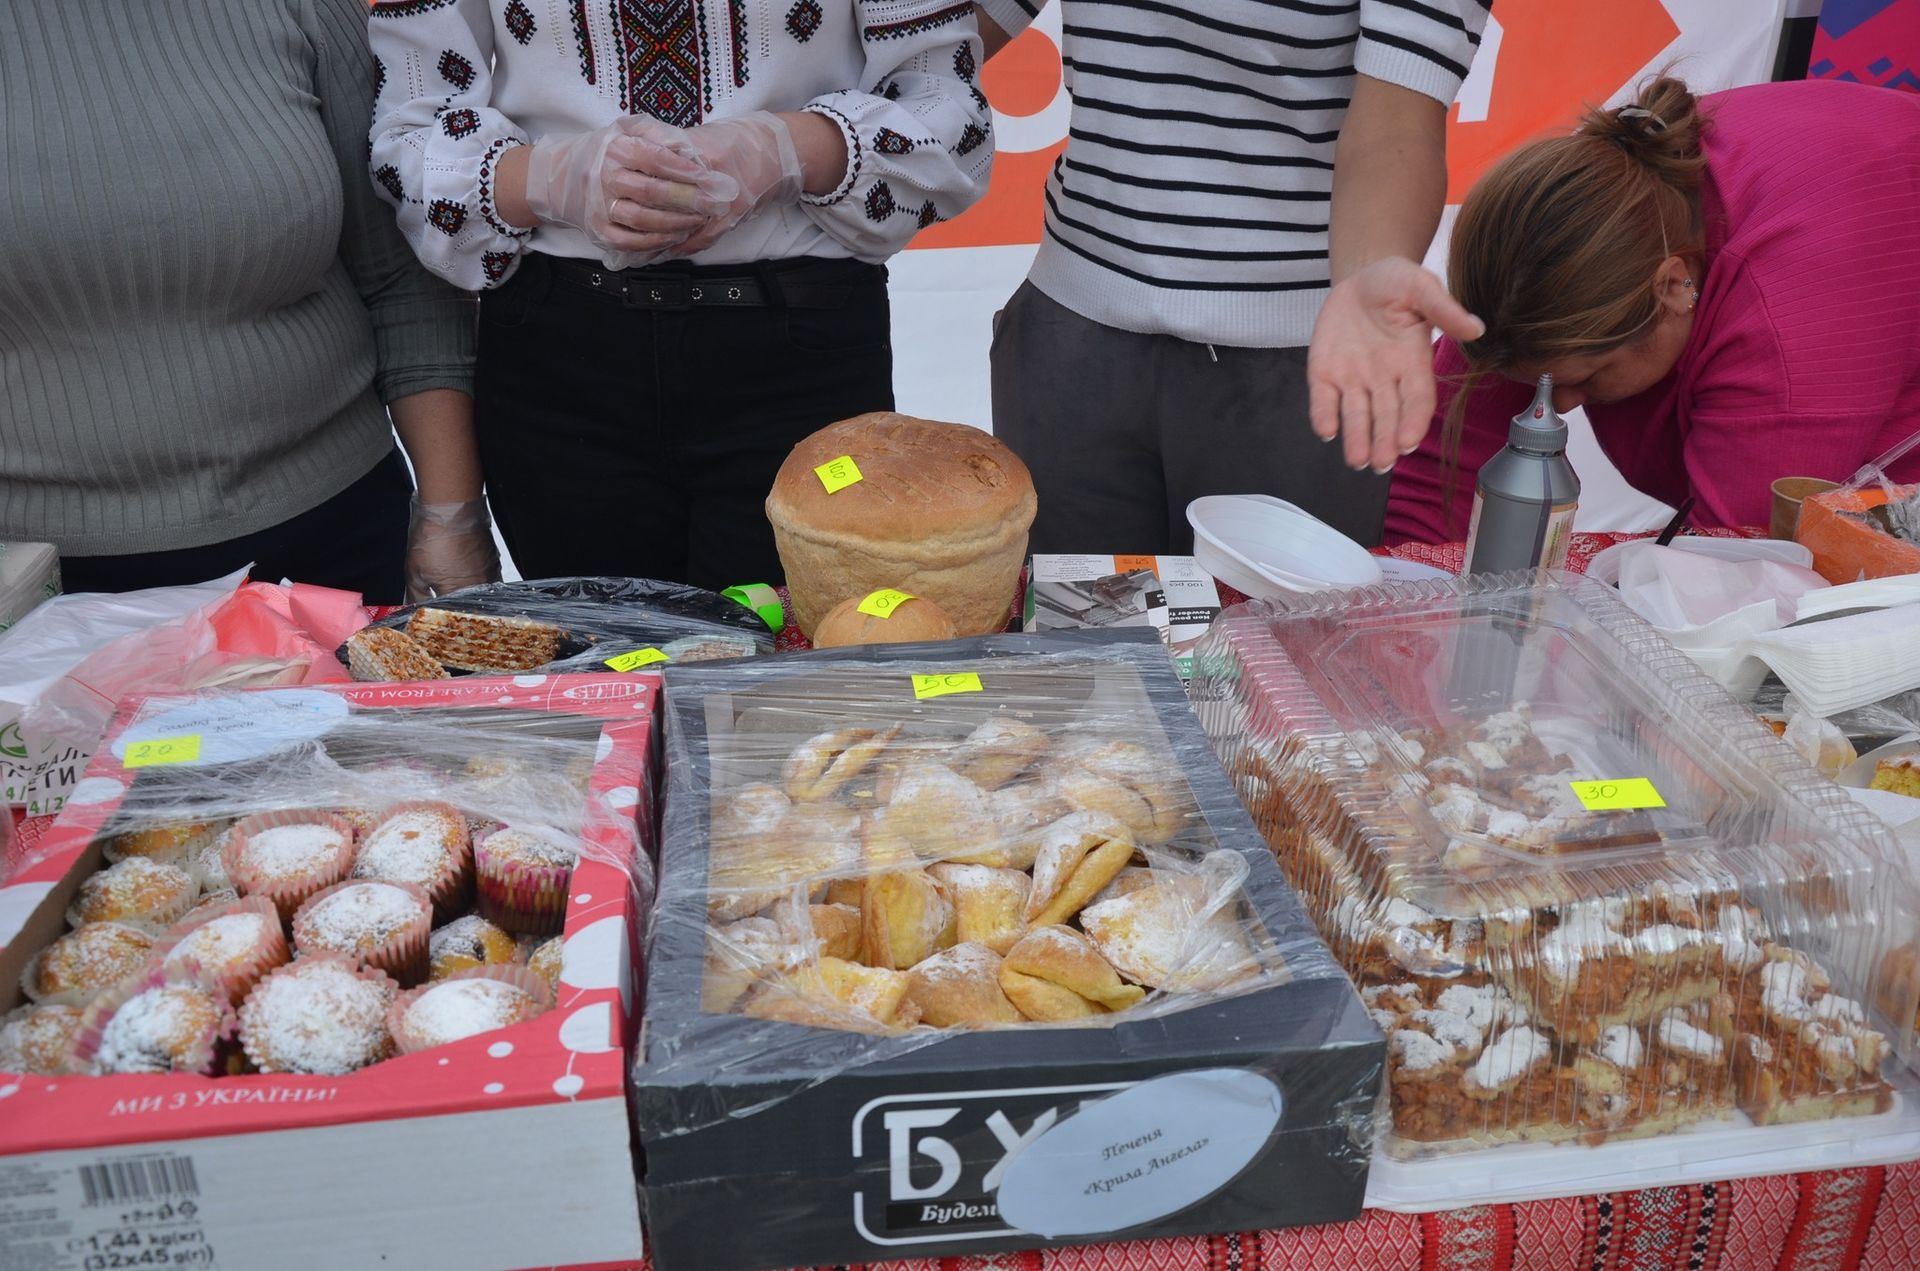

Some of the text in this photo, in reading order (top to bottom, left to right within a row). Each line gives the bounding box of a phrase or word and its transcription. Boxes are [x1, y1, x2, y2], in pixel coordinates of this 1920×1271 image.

[1178, 609, 1211, 617] Powder
[345, 685, 509, 700] WE ARE FROM UK
[573, 682, 638, 700] LUKAS
[133, 744, 173, 761] 20
[1583, 784, 1618, 801] 30
[109, 1086, 338, 1116] МИ З УКРАЇНИ!
[883, 1100, 1096, 1201] БХ
[1102, 1128, 1163, 1161] Печеня
[1147, 1137, 1210, 1176] Ангела»
[919, 1201, 998, 1223] Будем
